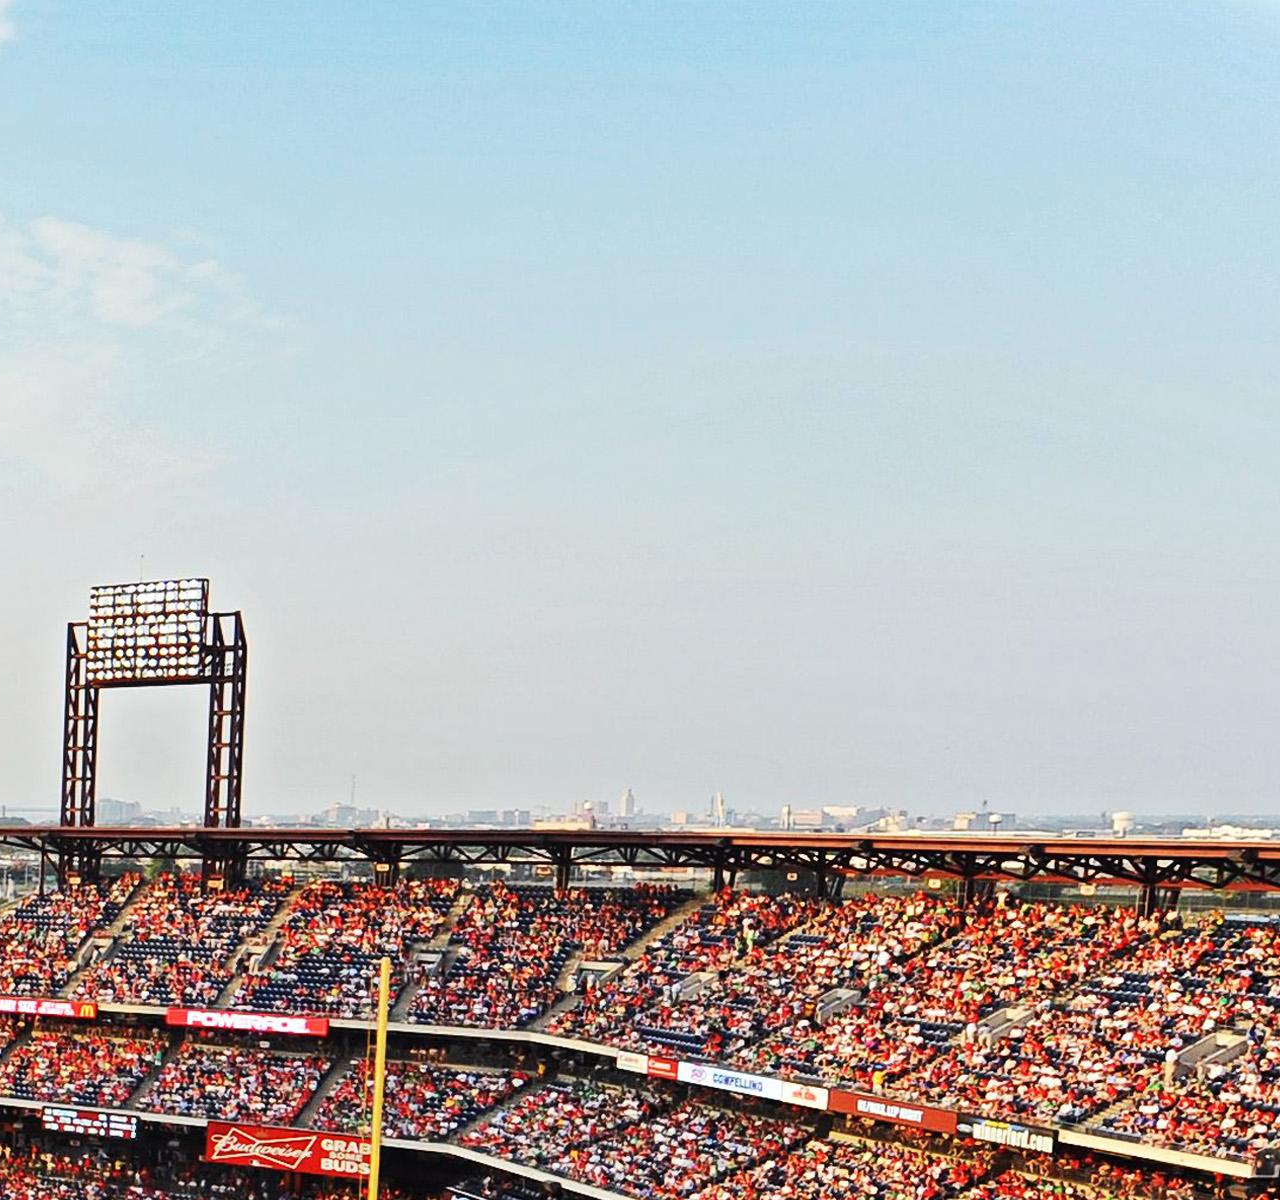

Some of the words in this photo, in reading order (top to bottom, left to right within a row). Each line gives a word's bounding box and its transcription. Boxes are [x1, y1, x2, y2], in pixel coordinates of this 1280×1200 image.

[211, 1133, 314, 1159] Budweiser
[321, 1138, 371, 1155] GRAB
[329, 1152, 364, 1162] SOME
[321, 1158, 371, 1175] BUDS
